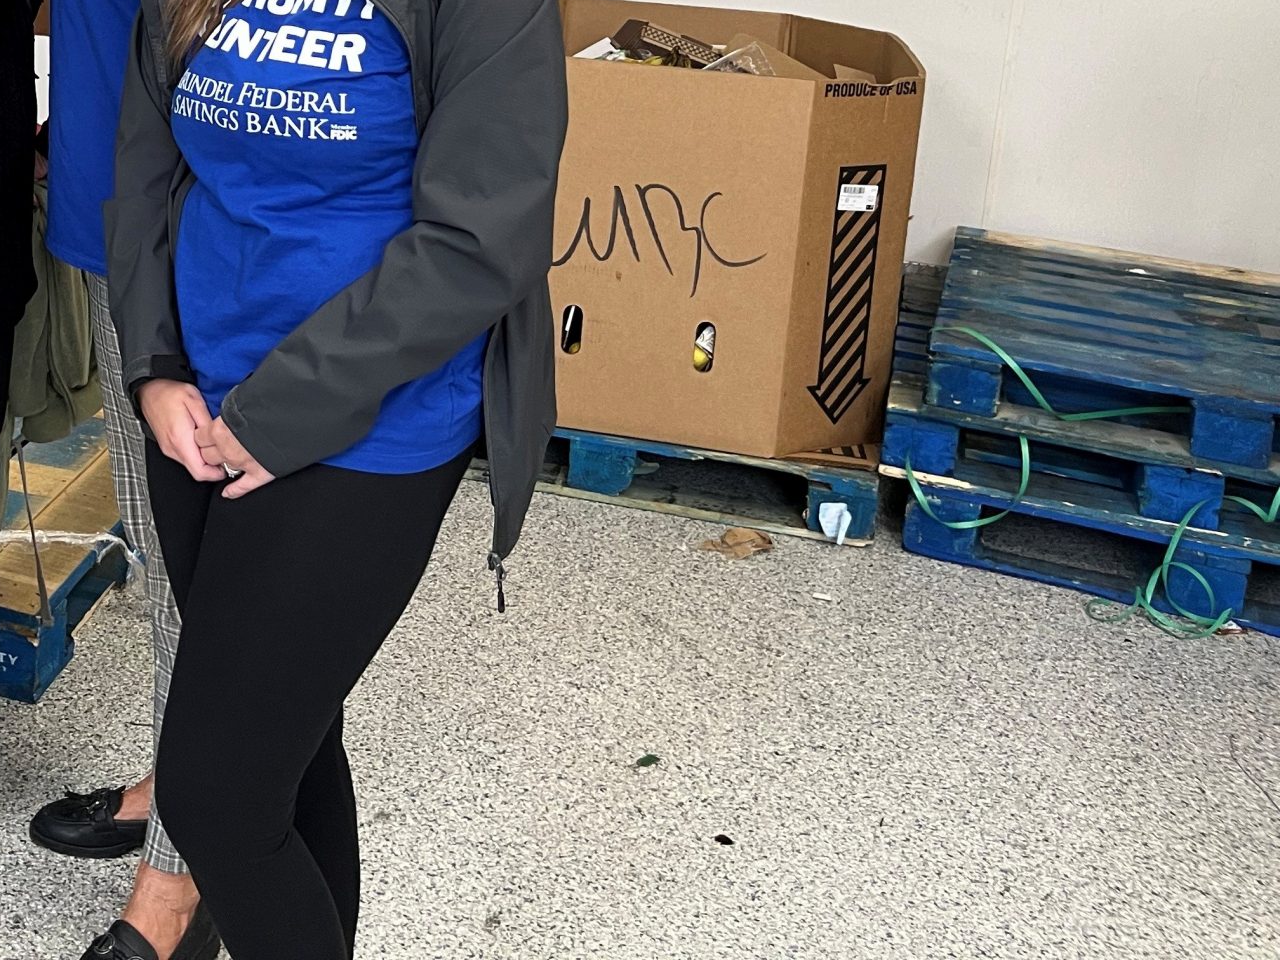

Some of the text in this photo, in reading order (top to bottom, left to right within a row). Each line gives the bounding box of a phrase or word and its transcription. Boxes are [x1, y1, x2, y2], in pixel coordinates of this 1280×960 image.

[236, 82, 356, 115] FEDERAL
[824, 83, 877, 97] PRODUCE
[896, 80, 917, 96] USA
[173, 94, 330, 140] SAVINGS BANK
